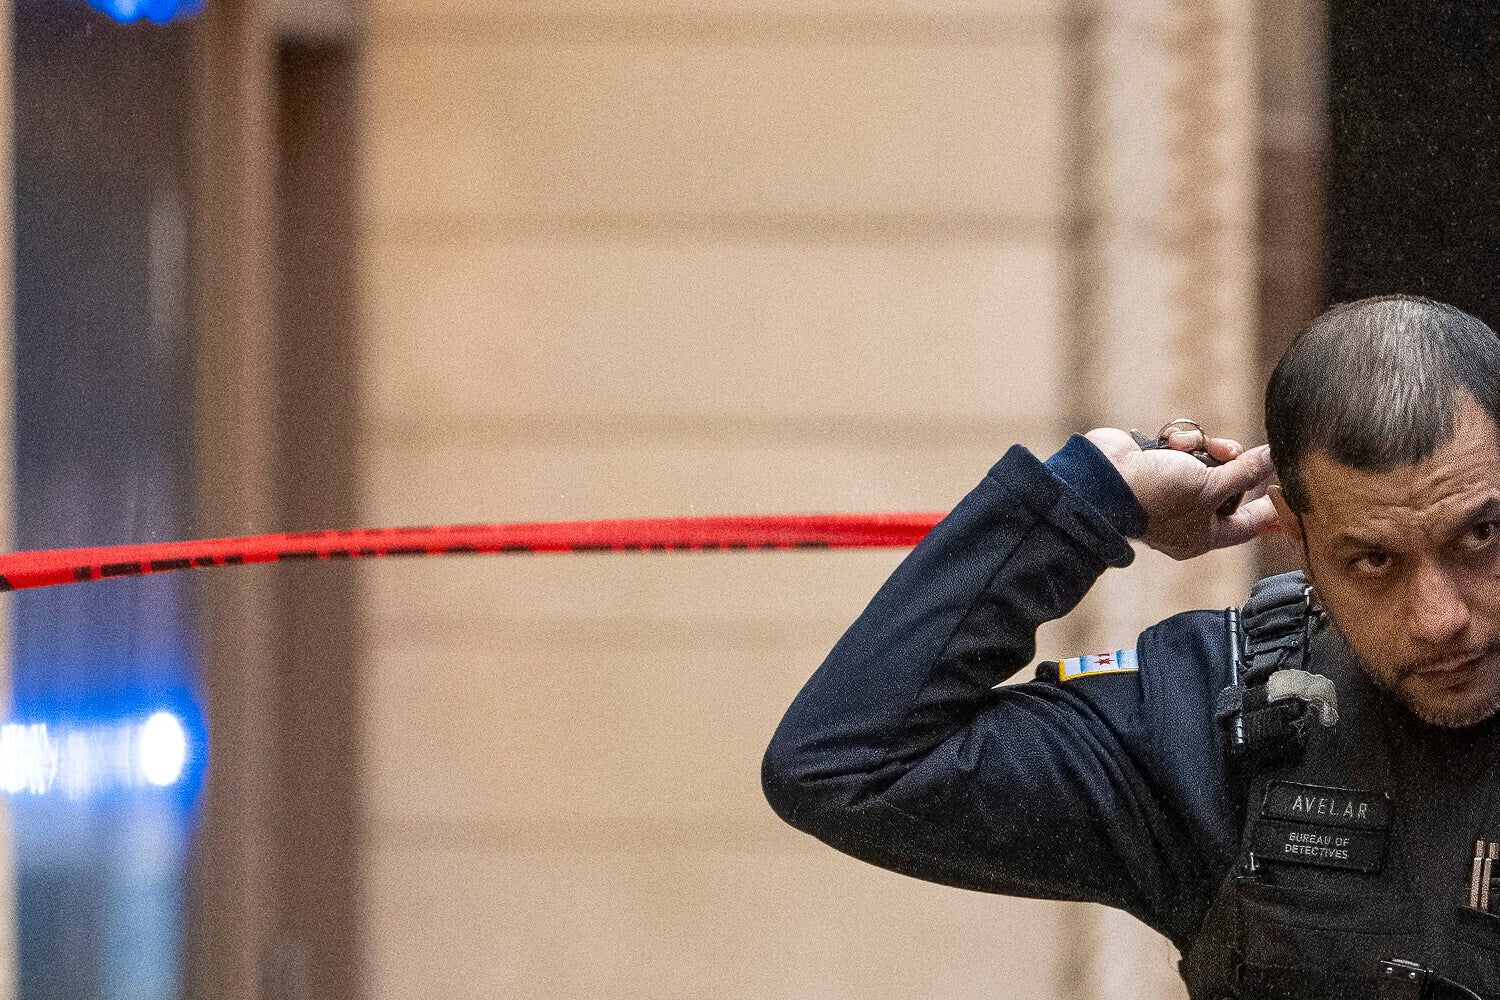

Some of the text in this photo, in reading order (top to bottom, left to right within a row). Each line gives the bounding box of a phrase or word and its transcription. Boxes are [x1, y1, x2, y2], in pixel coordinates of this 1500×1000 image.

[1292, 795, 1368, 818] AVELAR
[1289, 832, 1350, 847] BUREAU OF
[1285, 843, 1348, 860] DETECTIVES
